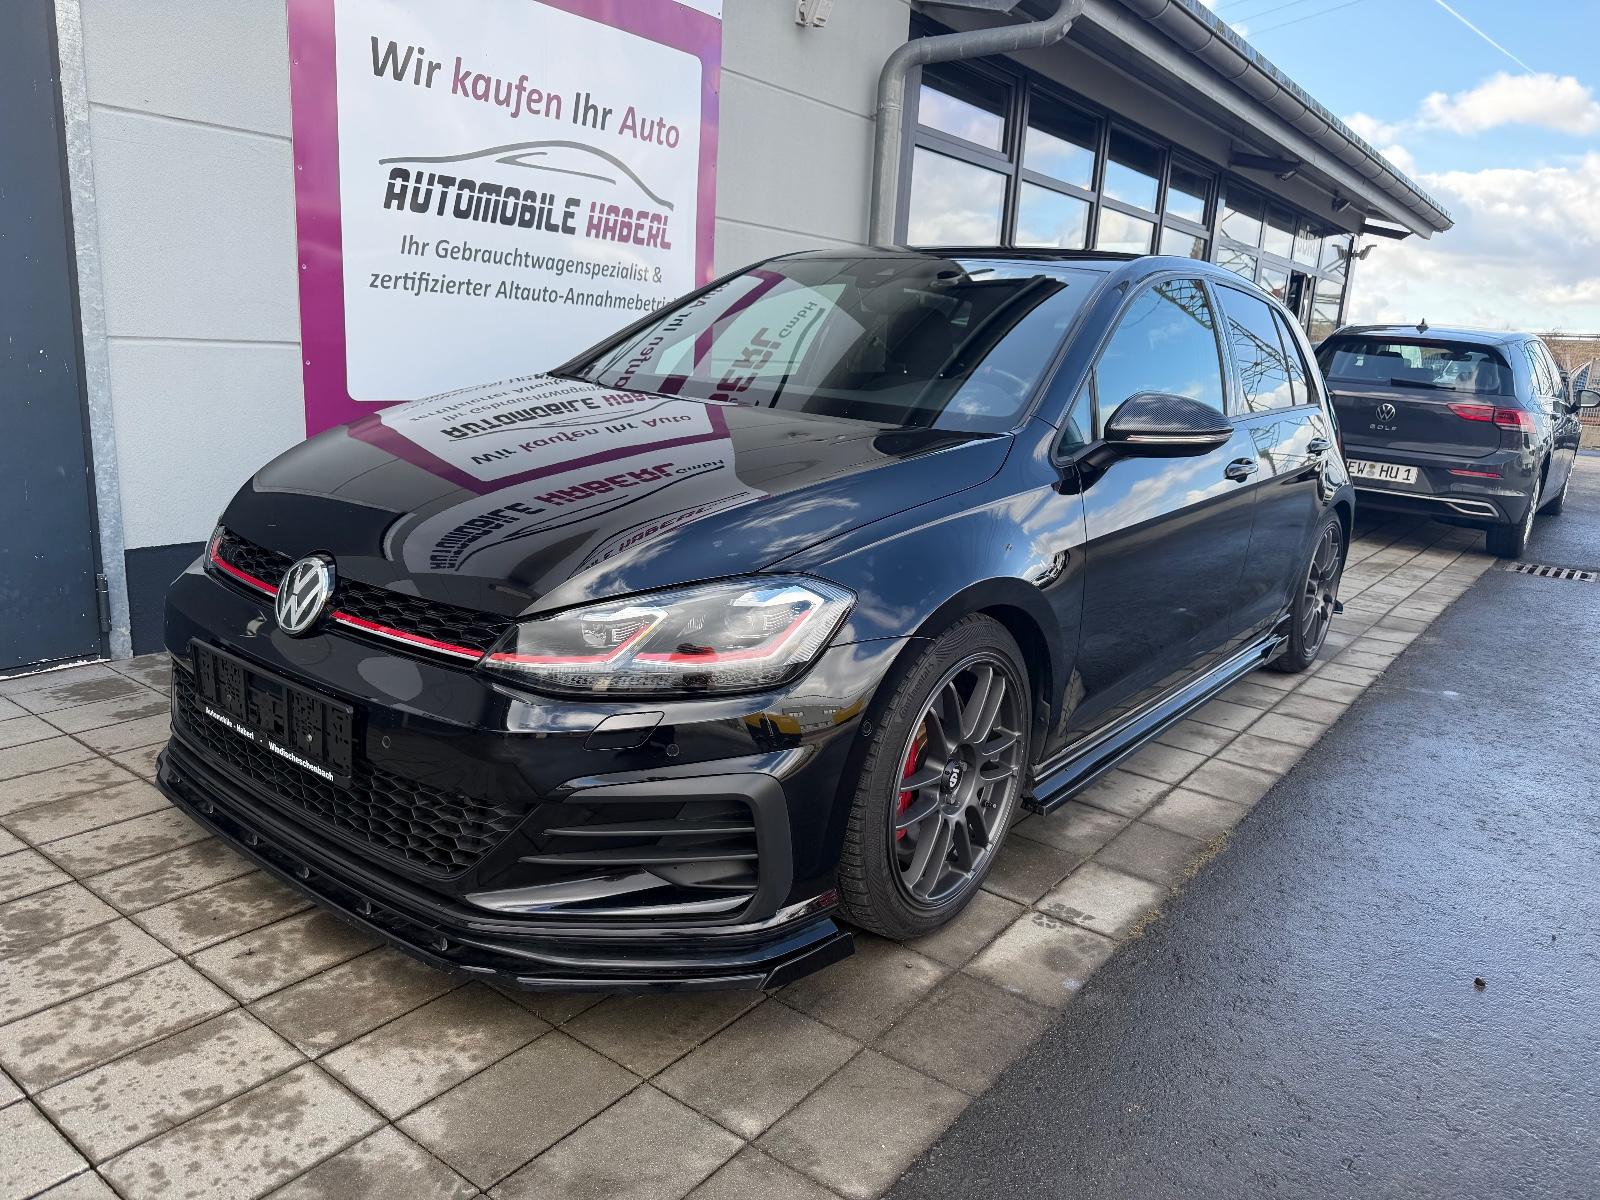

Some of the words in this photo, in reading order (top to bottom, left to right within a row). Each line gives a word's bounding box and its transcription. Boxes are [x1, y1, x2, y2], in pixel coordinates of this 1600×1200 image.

[370, 36, 442, 88] Wir
[451, 57, 562, 119] kaufen
[572, 92, 613, 130] Ihr
[618, 106, 680, 149] Auto
[383, 167, 582, 235] AUTOMOBILE
[586, 201, 672, 250] HABERL
[400, 235, 430, 257] Ihr
[435, 239, 649, 283] Gebrauchtwagenspezialist
[652, 266, 662, 284] &
[369, 271, 492, 298] zertifizierter
[495, 280, 676, 313] Altauto-Annahmebetri
[1380, 465, 1400, 479] HU
[1403, 469, 1411, 480] 1
[268, 740, 334, 782] Windischeschenbach
